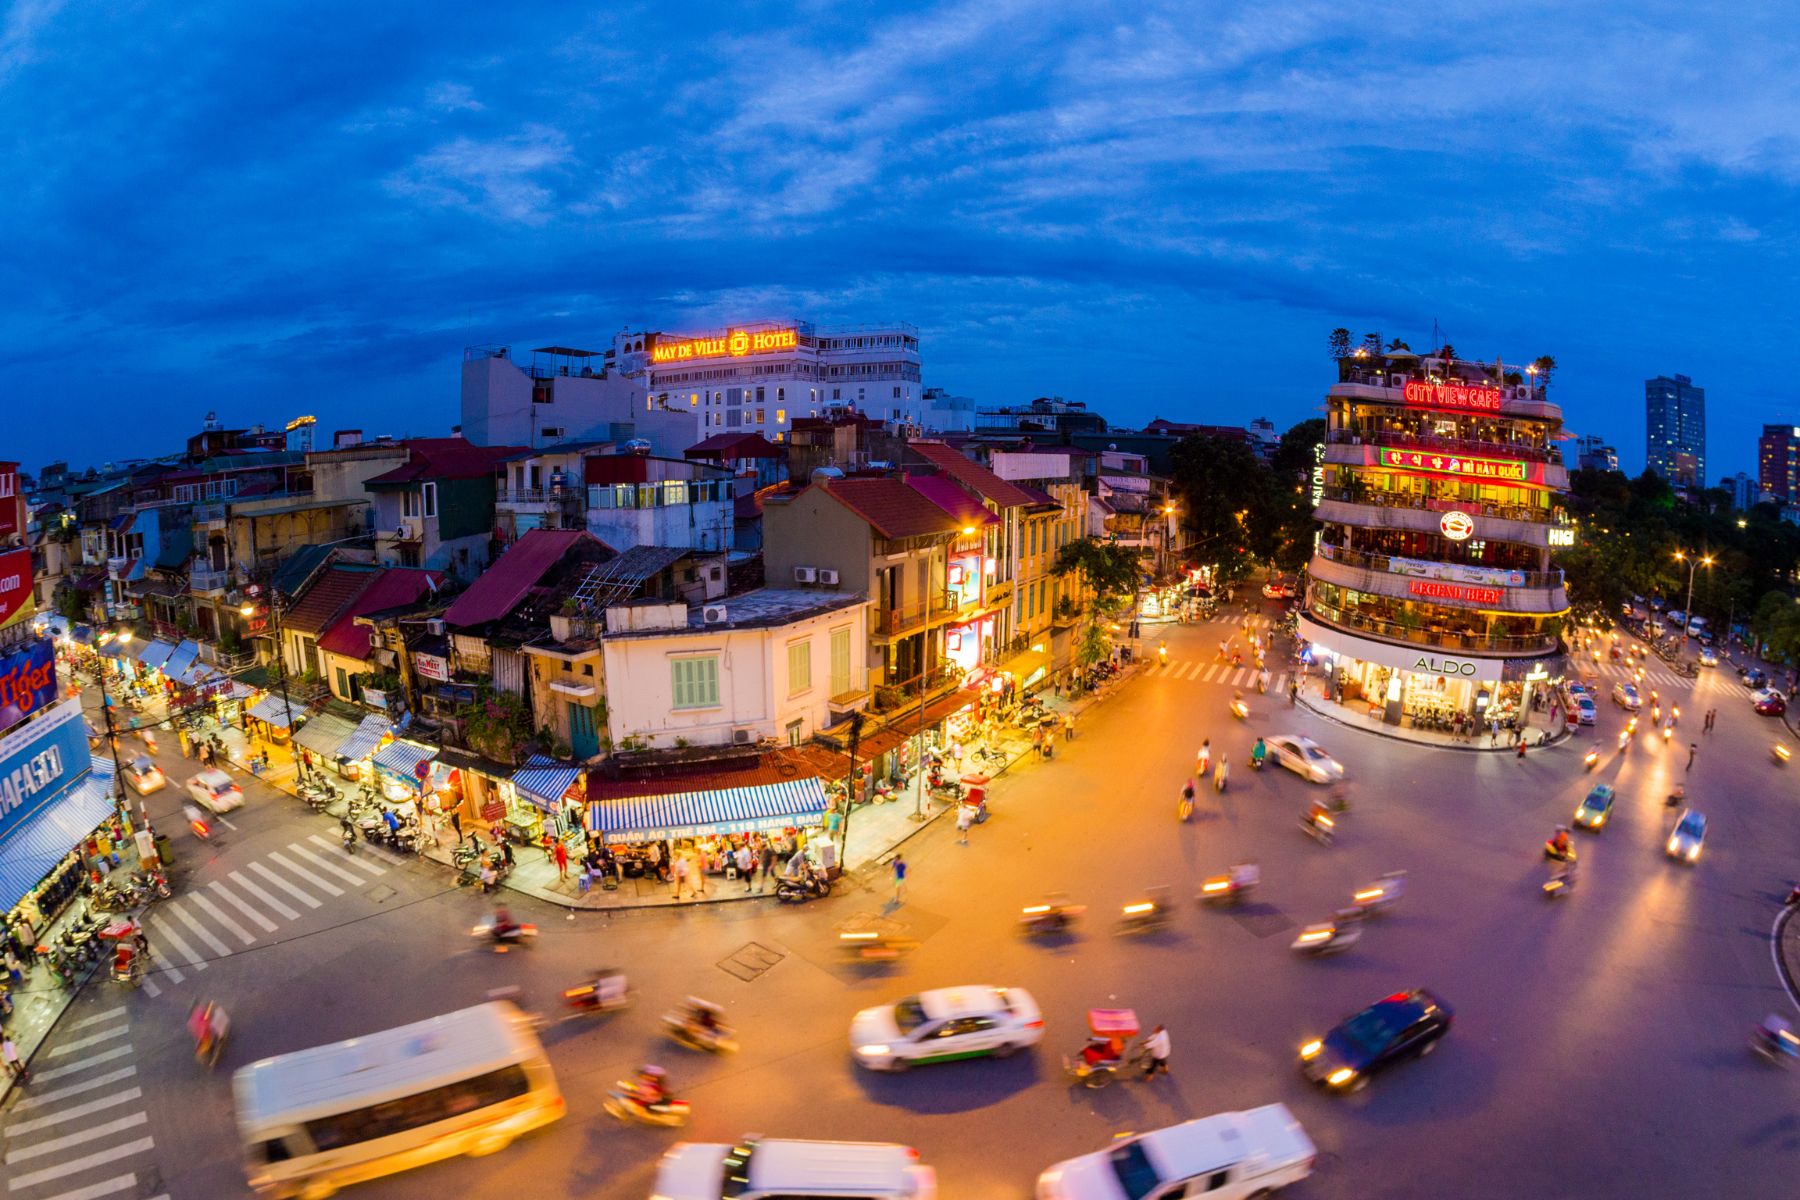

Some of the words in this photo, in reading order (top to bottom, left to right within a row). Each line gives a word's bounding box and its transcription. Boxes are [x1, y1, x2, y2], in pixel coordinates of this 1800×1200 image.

[654, 346, 677, 361] MAY
[678, 344, 692, 358] DE
[694, 340, 726, 355] VILLE
[754, 332, 796, 349] HOTEL
[1406, 383, 1433, 402] CITY
[1436, 386, 1468, 405] VIEW
[1469, 389, 1499, 409] CAFE
[1410, 581, 1462, 598] LEGEND
[1466, 588, 1501, 604] BEER
[1414, 658, 1476, 676] ALDO
[0, 659, 52, 712] Tiger
